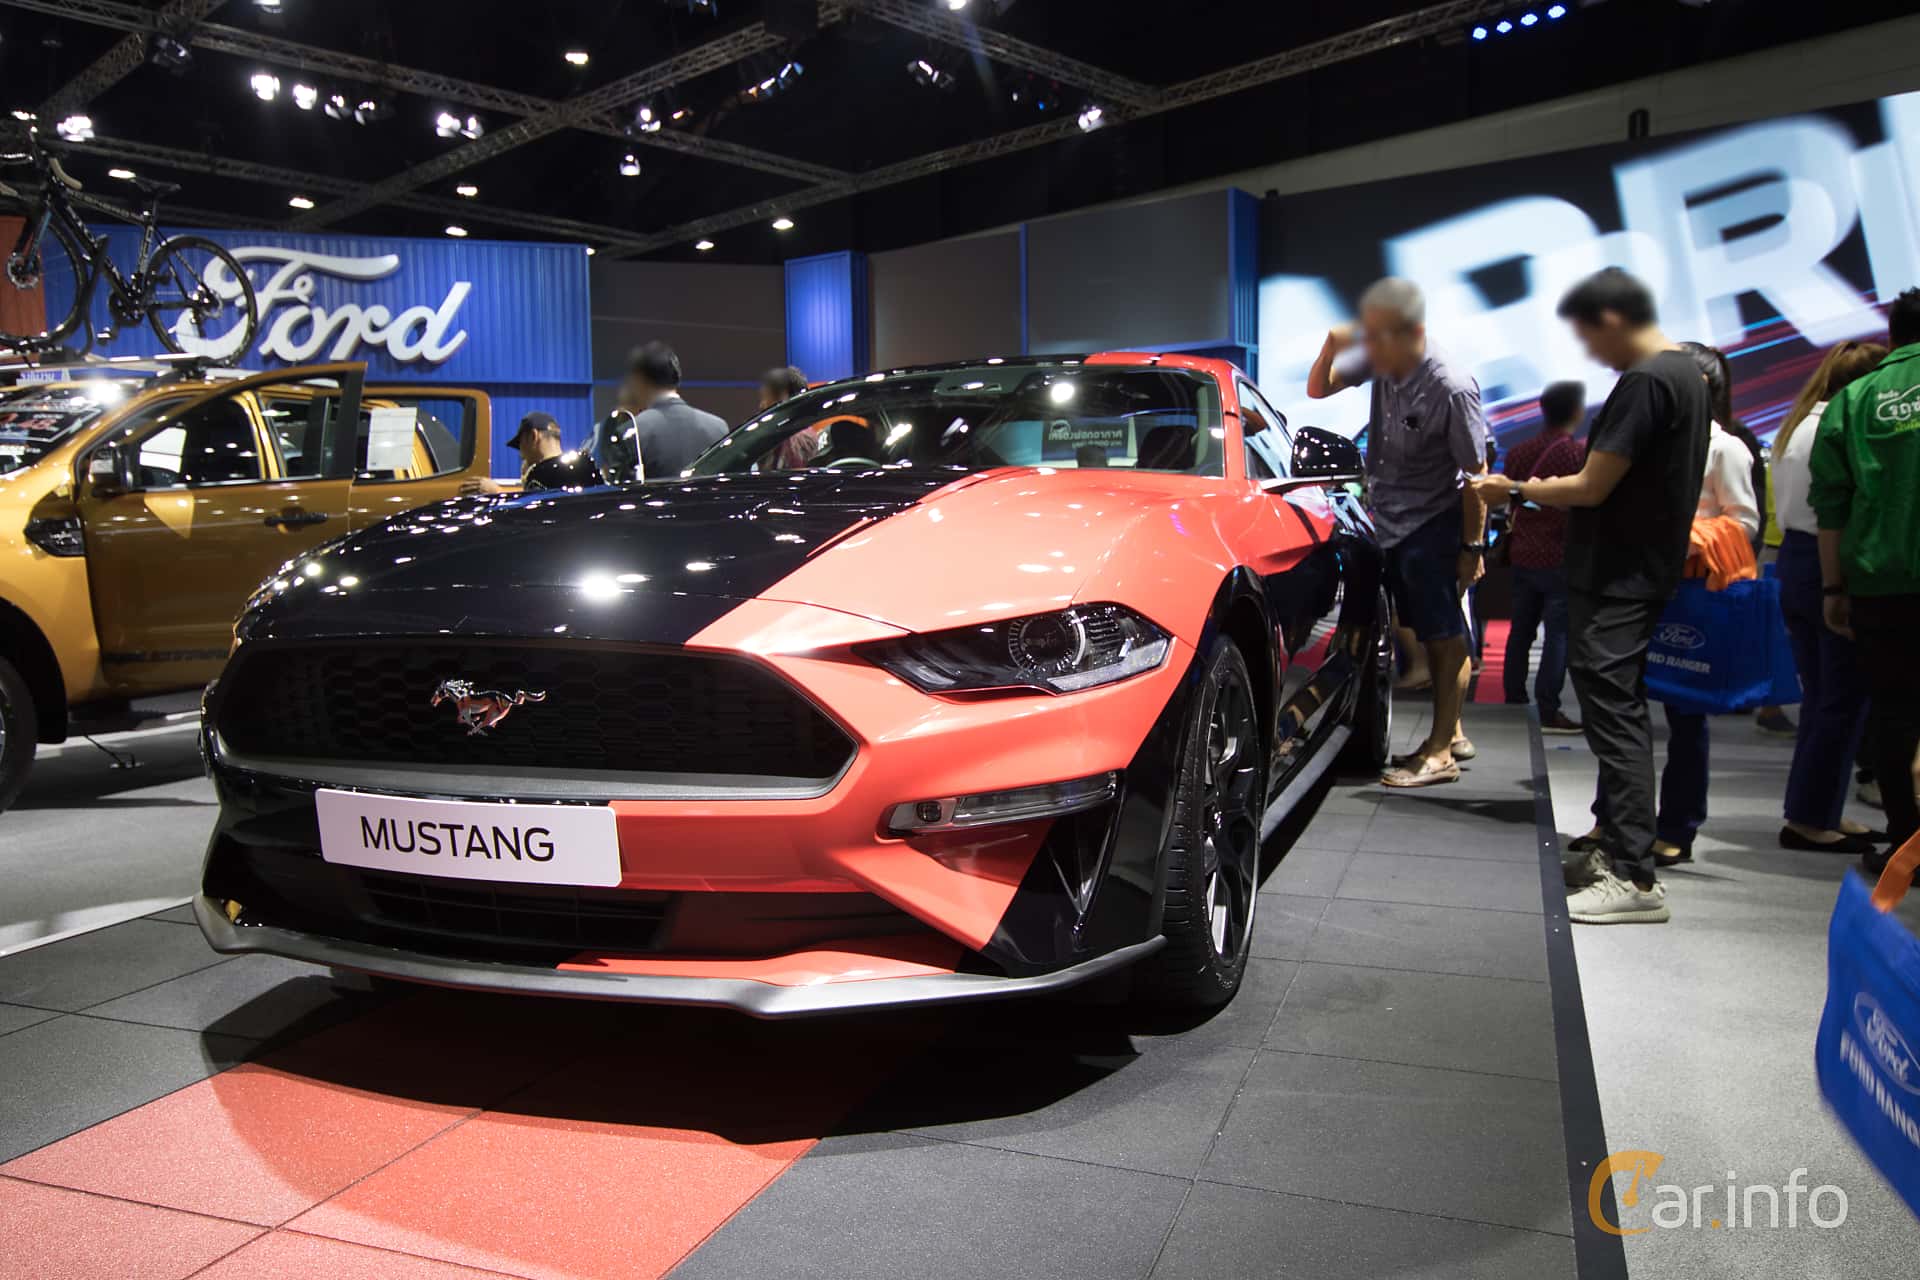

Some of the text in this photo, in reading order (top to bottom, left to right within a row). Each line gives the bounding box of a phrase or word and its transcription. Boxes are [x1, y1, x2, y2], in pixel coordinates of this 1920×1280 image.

[174, 246, 472, 362] Ford
[1666, 656, 1711, 673] RANGER
[360, 815, 555, 862] MUSTANG
[1866, 1007, 1909, 1081] Ford
[1840, 1028, 1920, 1149] FORD RANG
